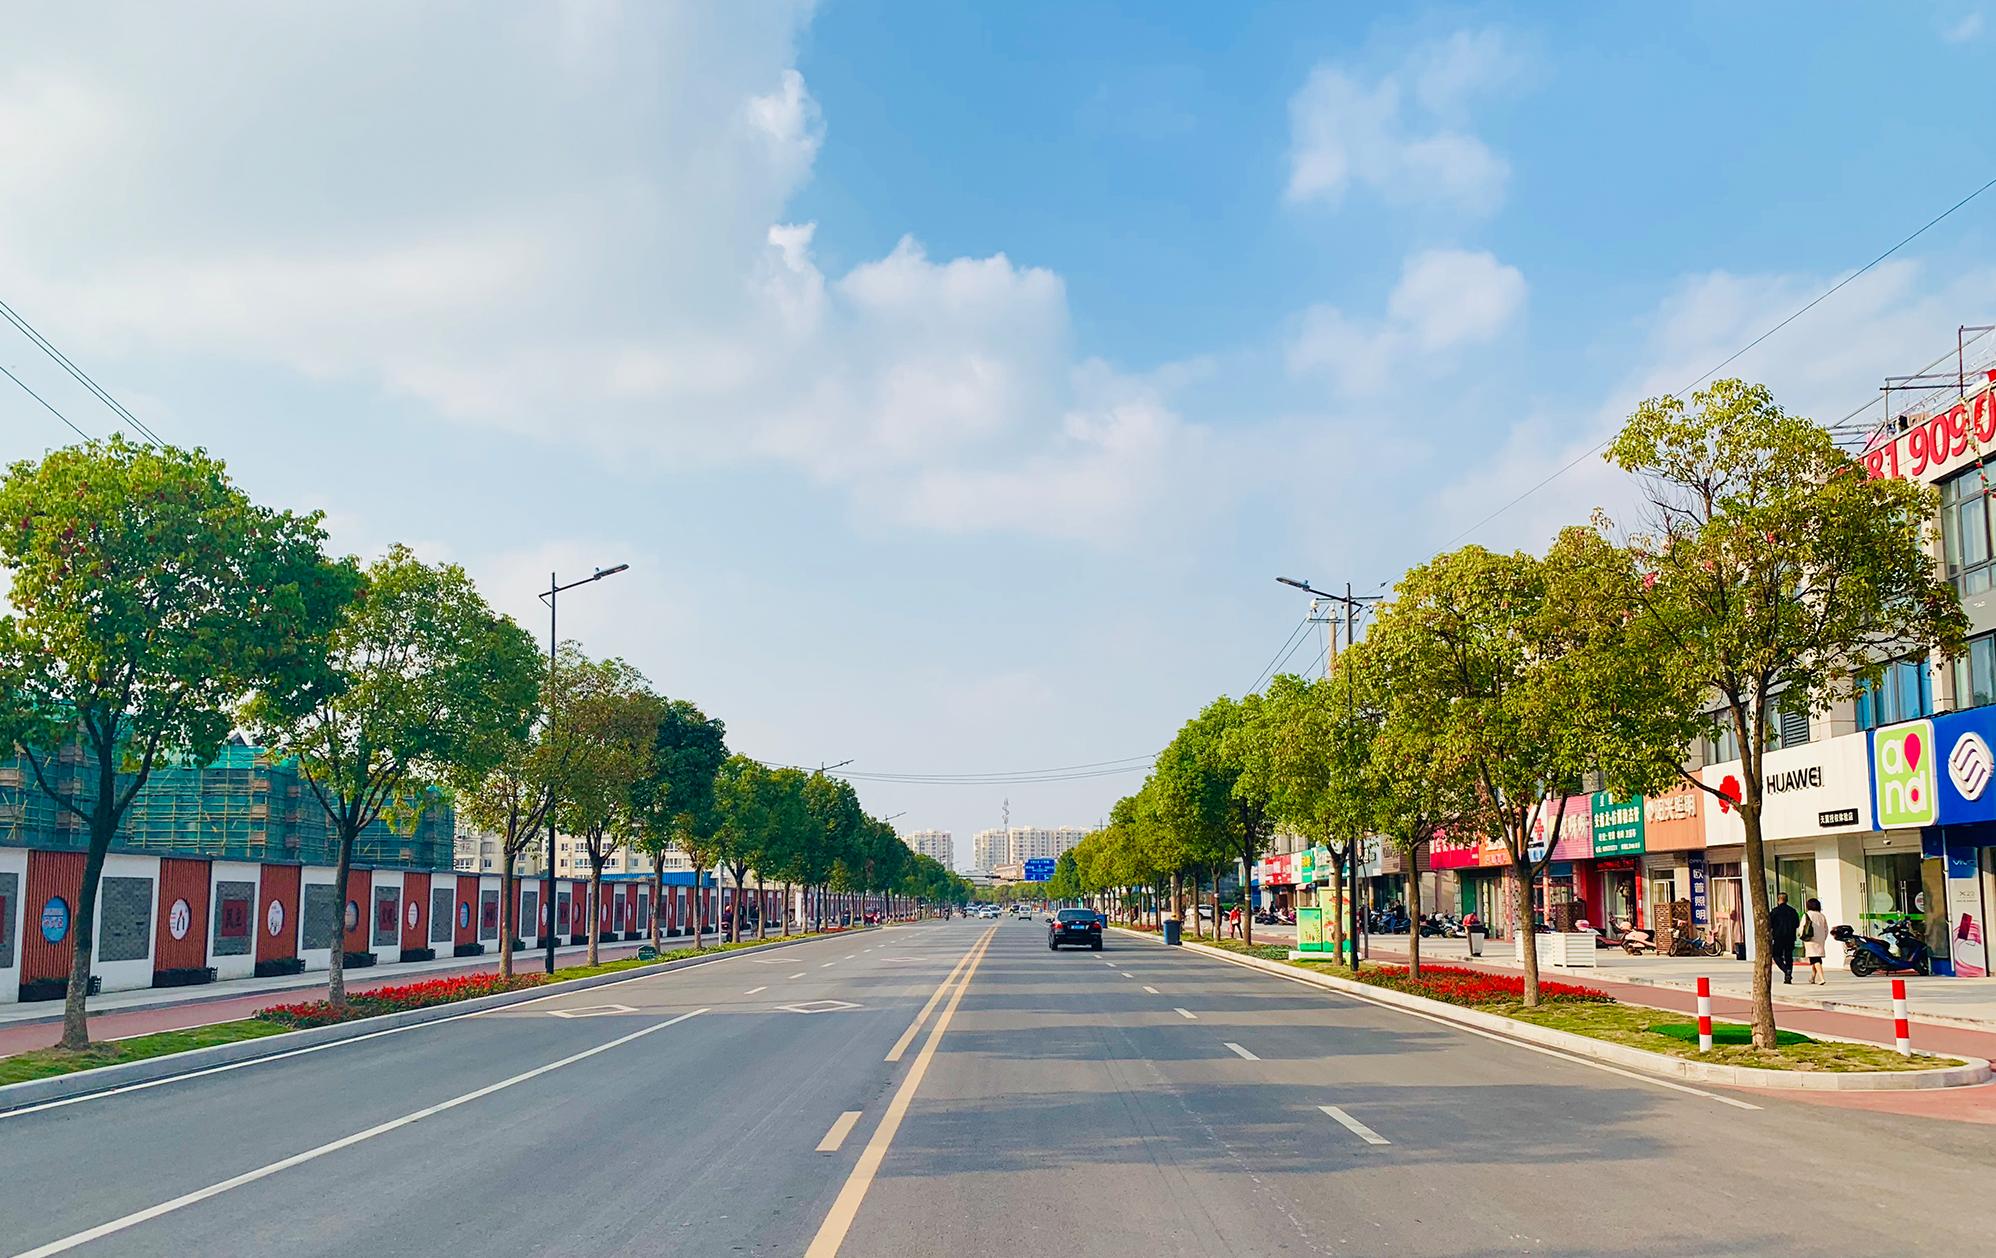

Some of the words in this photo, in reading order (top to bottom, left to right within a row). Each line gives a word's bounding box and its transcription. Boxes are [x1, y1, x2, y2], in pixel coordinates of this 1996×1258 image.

[1766, 766, 1822, 794] HUAWEI
[1693, 868, 1706, 920] 欧普照明
